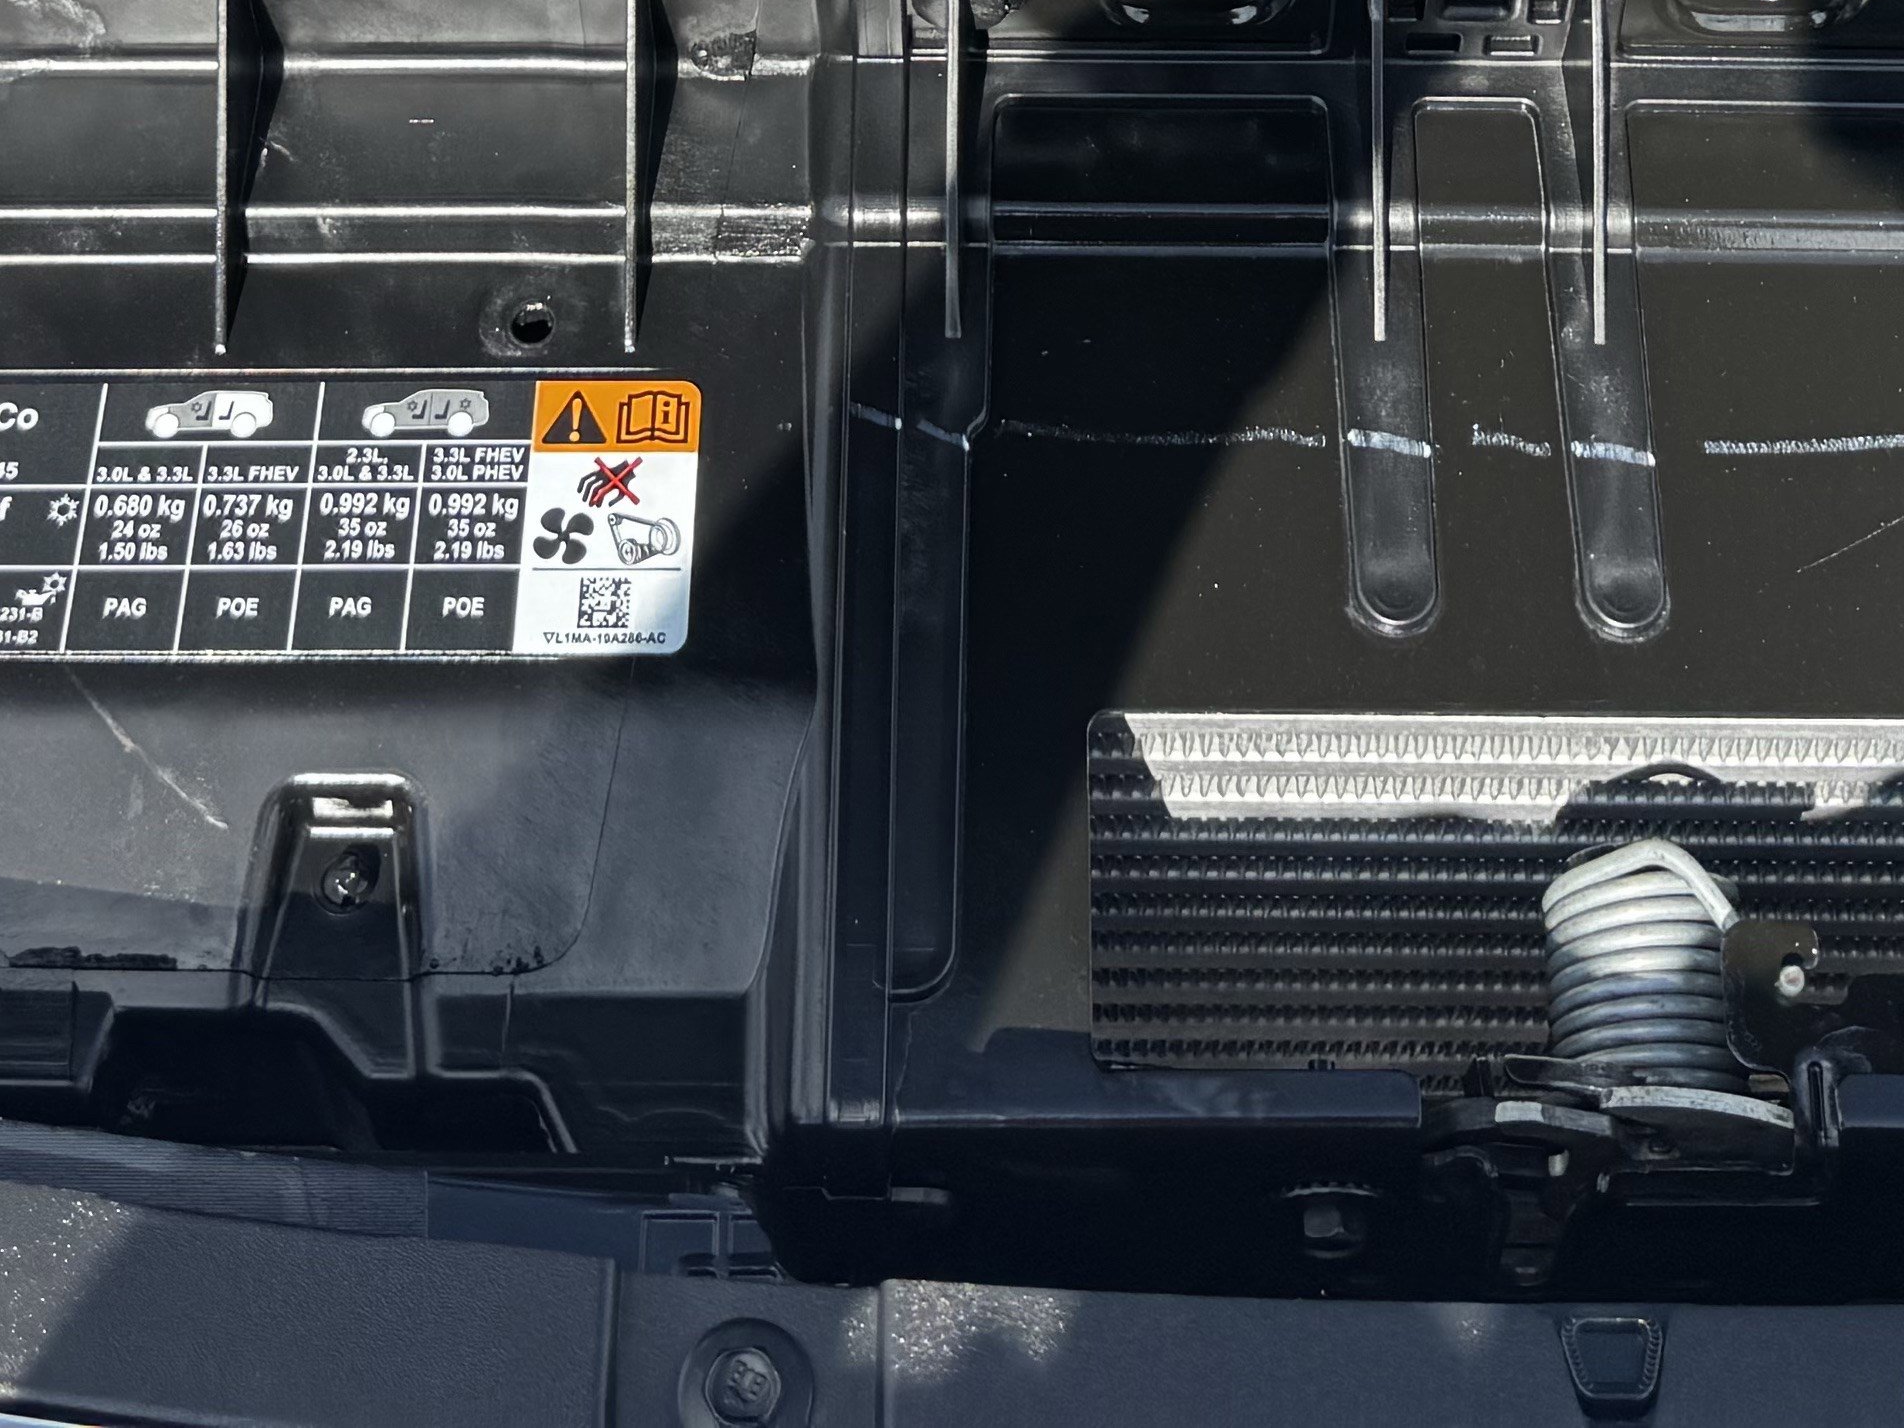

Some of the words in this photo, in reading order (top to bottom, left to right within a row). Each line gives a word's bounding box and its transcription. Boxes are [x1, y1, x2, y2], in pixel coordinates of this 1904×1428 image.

[346, 447, 388, 464] 2.3L,
[433, 447, 470, 463] 3.3L
[474, 447, 525, 463] FHEV
[96, 466, 133, 482] 3.0L
[137, 466, 151, 482] &
[156, 466, 193, 482] 3.3L
[207, 466, 244, 482] 3.3L
[248, 466, 299, 482] FHEV
[317, 465, 354, 481] 3.0L
[358, 465, 372, 481] &
[377, 465, 414, 481] 3.3L
[431, 465, 468, 481] 3.0L
[472, 465, 524, 481] PHEV
[94, 494, 153, 517] 0.680
[157, 494, 185, 522] kg
[203, 494, 262, 517] 0.737
[265, 494, 293, 522] kg
[319, 493, 378, 516] 0.992
[382, 493, 410, 521] kg
[428, 493, 487, 516] 0.992
[491, 493, 519, 521] kg
[111, 520, 134, 539] 24
[138, 523, 161, 539] oz
[220, 519, 243, 539] 26
[246, 523, 270, 539] oz
[337, 518, 360, 537] 35
[364, 521, 387, 537] oz
[447, 518, 470, 537] 35
[473, 521, 496, 537] oz
[98, 541, 136, 560] 1.50
[139, 541, 168, 560] lbs
[207, 541, 244, 560] 1.63
[248, 541, 277, 560] lbs
[324, 540, 363, 560] 2.19
[366, 540, 395, 560] lbs
[433, 541, 472, 560] 2.19
[476, 541, 505, 560] lbs
[102, 597, 147, 617] PAG
[215, 597, 259, 617] POE
[328, 597, 372, 617] PAG
[442, 597, 485, 617] POE
